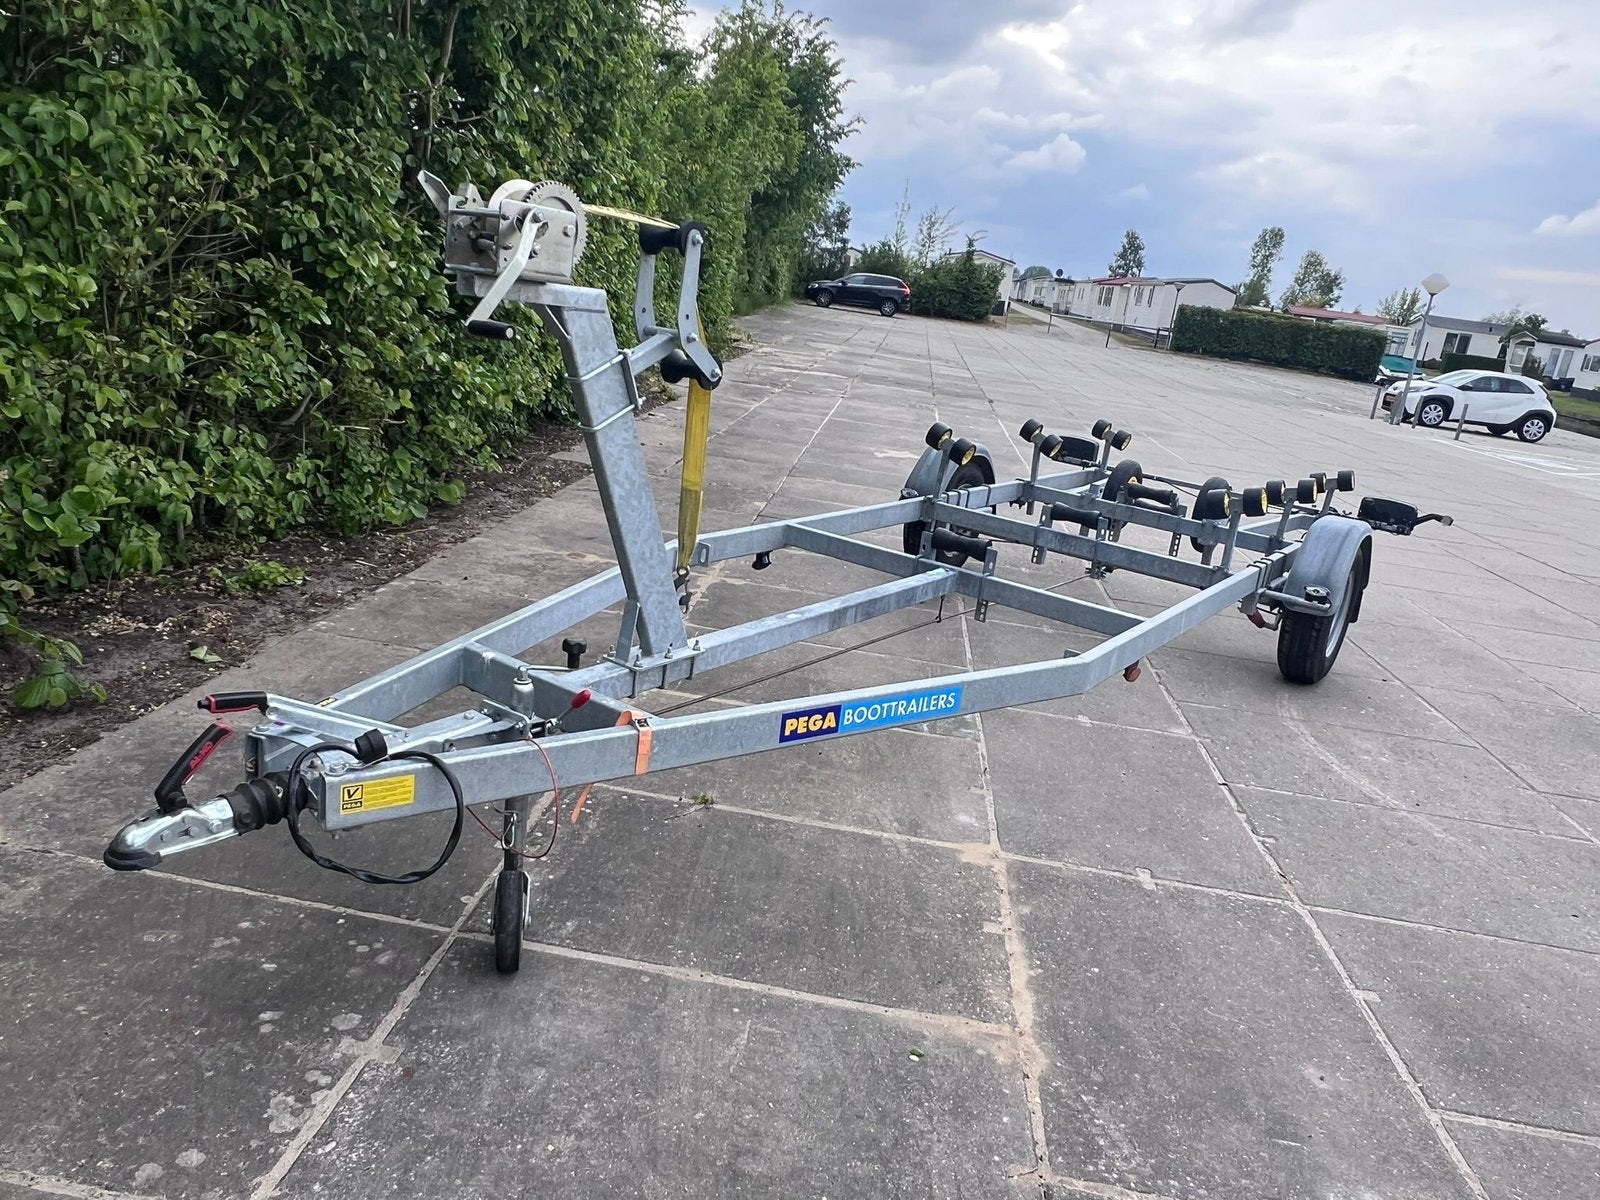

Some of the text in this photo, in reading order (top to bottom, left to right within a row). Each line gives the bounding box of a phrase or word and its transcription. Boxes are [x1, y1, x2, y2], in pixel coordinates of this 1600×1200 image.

[784, 692, 956, 737] PEGA BOOTTRAILERS
[343, 801, 362, 809] PEGA
